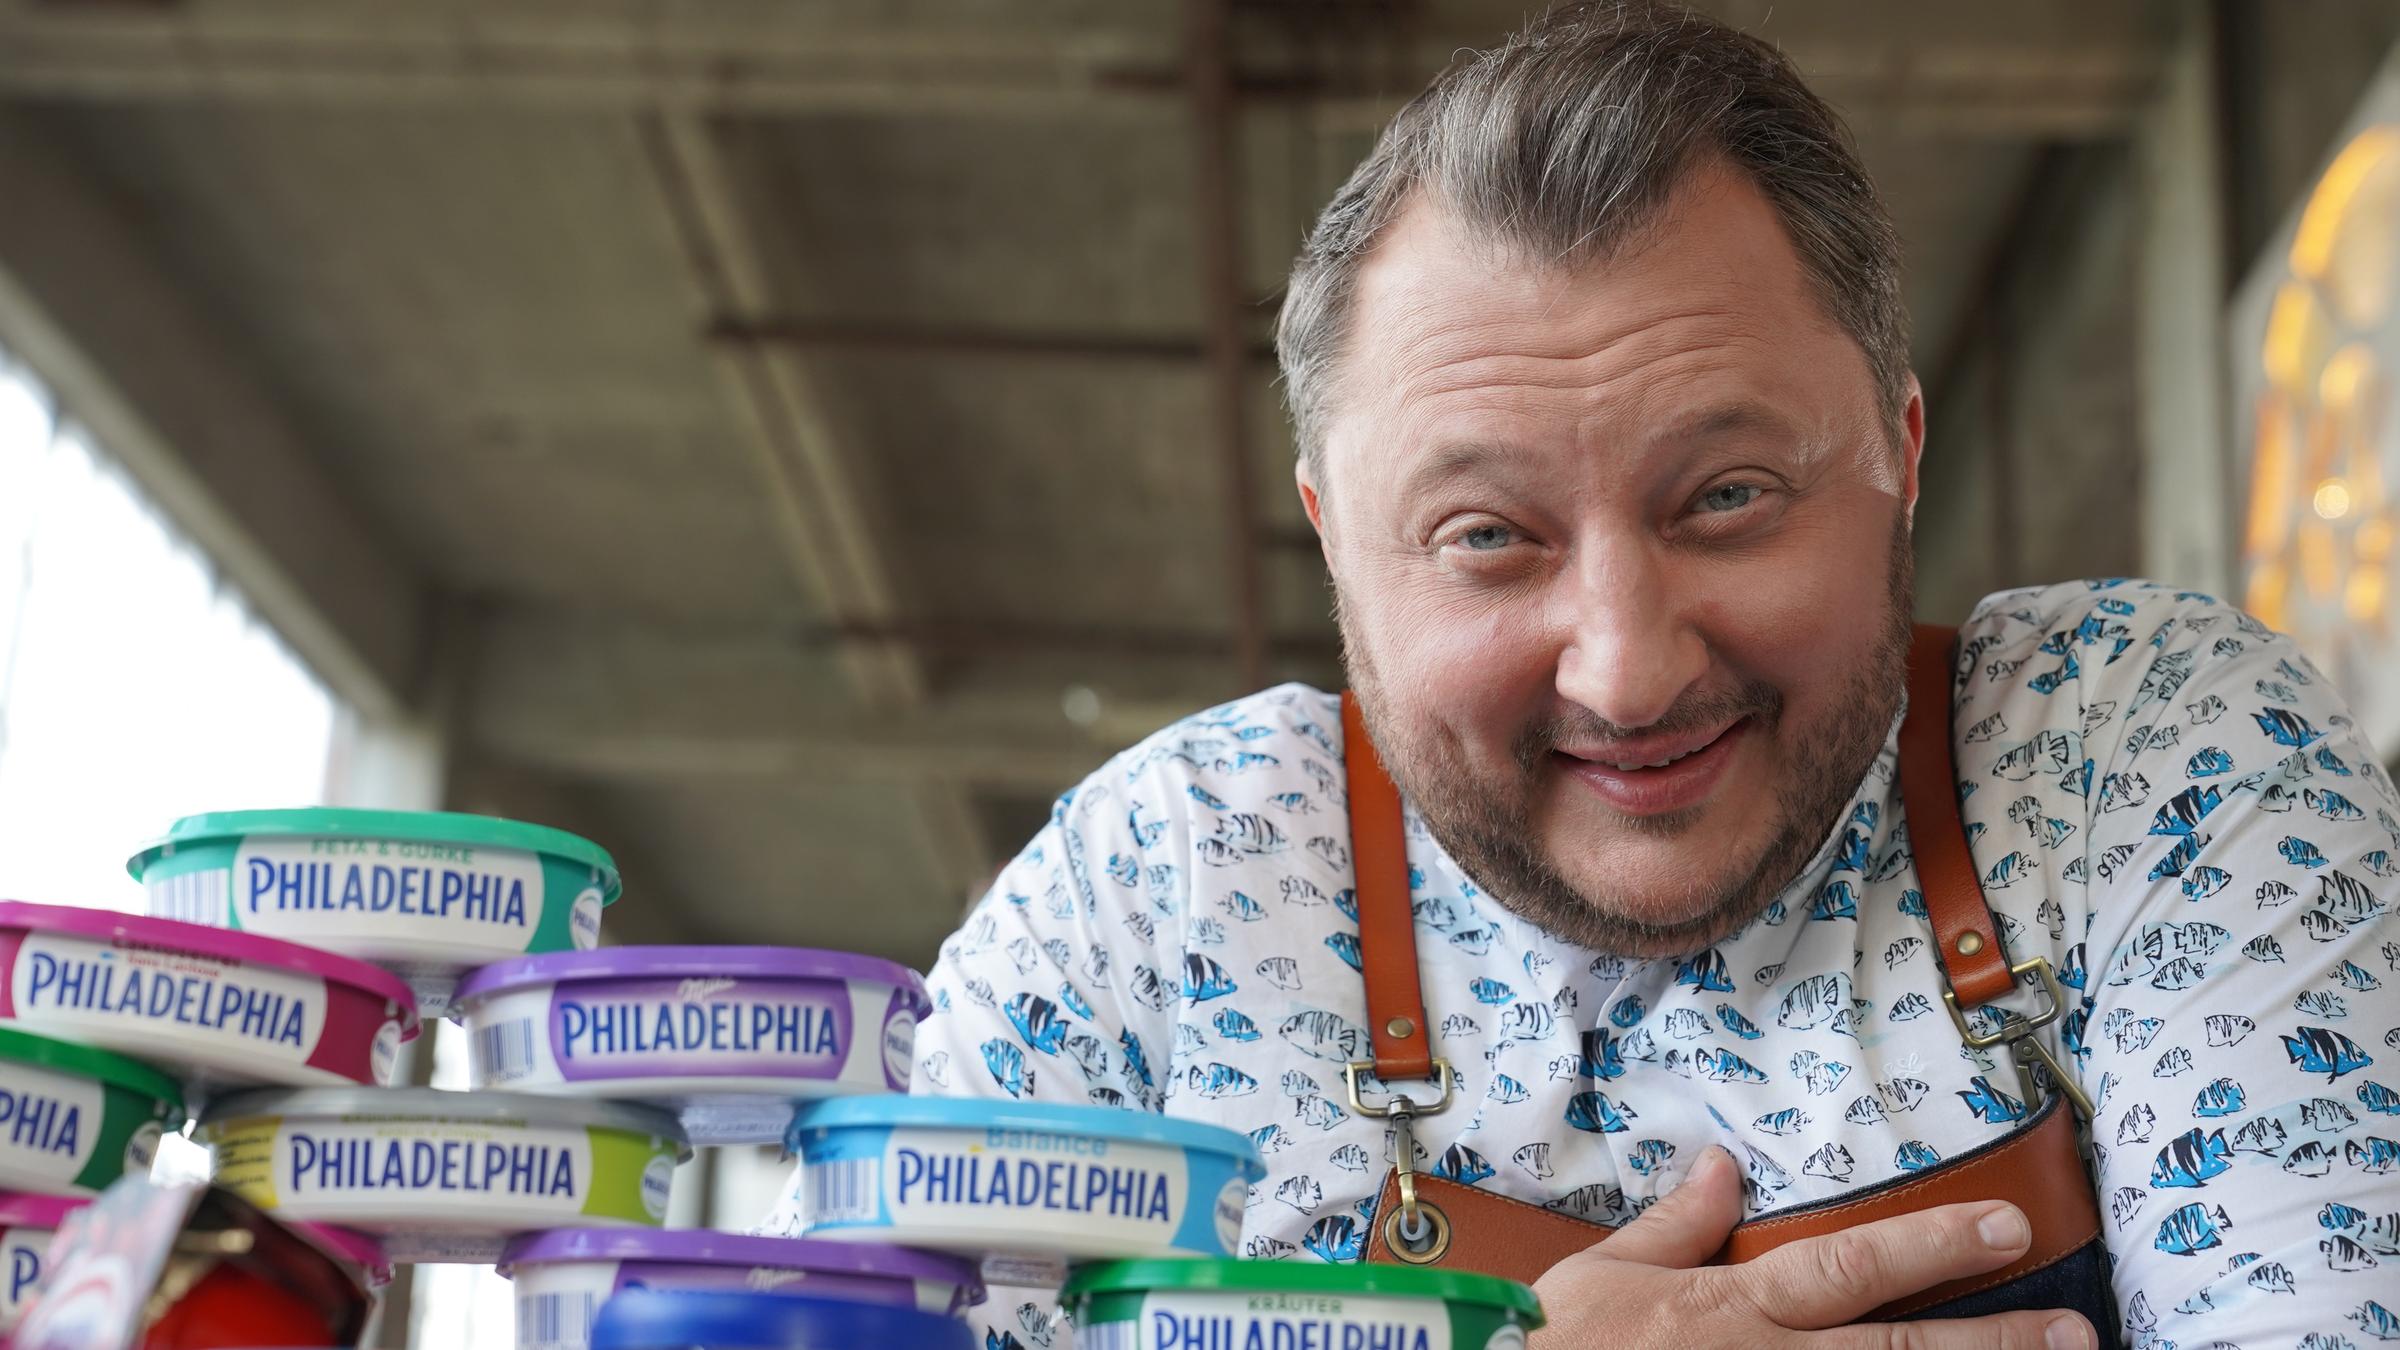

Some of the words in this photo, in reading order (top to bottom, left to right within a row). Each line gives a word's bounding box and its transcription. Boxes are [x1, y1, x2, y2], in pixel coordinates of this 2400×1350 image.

[248, 857, 526, 927] PHILADELPHIA
[29, 952, 305, 1048] PHILADELPHIA
[561, 1002, 840, 1059] PHILADELPHIA
[290, 1134, 575, 1198] PHILADELPHIA
[897, 1149, 1172, 1223] PHILADELPHIA
[1247, 1294, 1343, 1314] KRÄUTER
